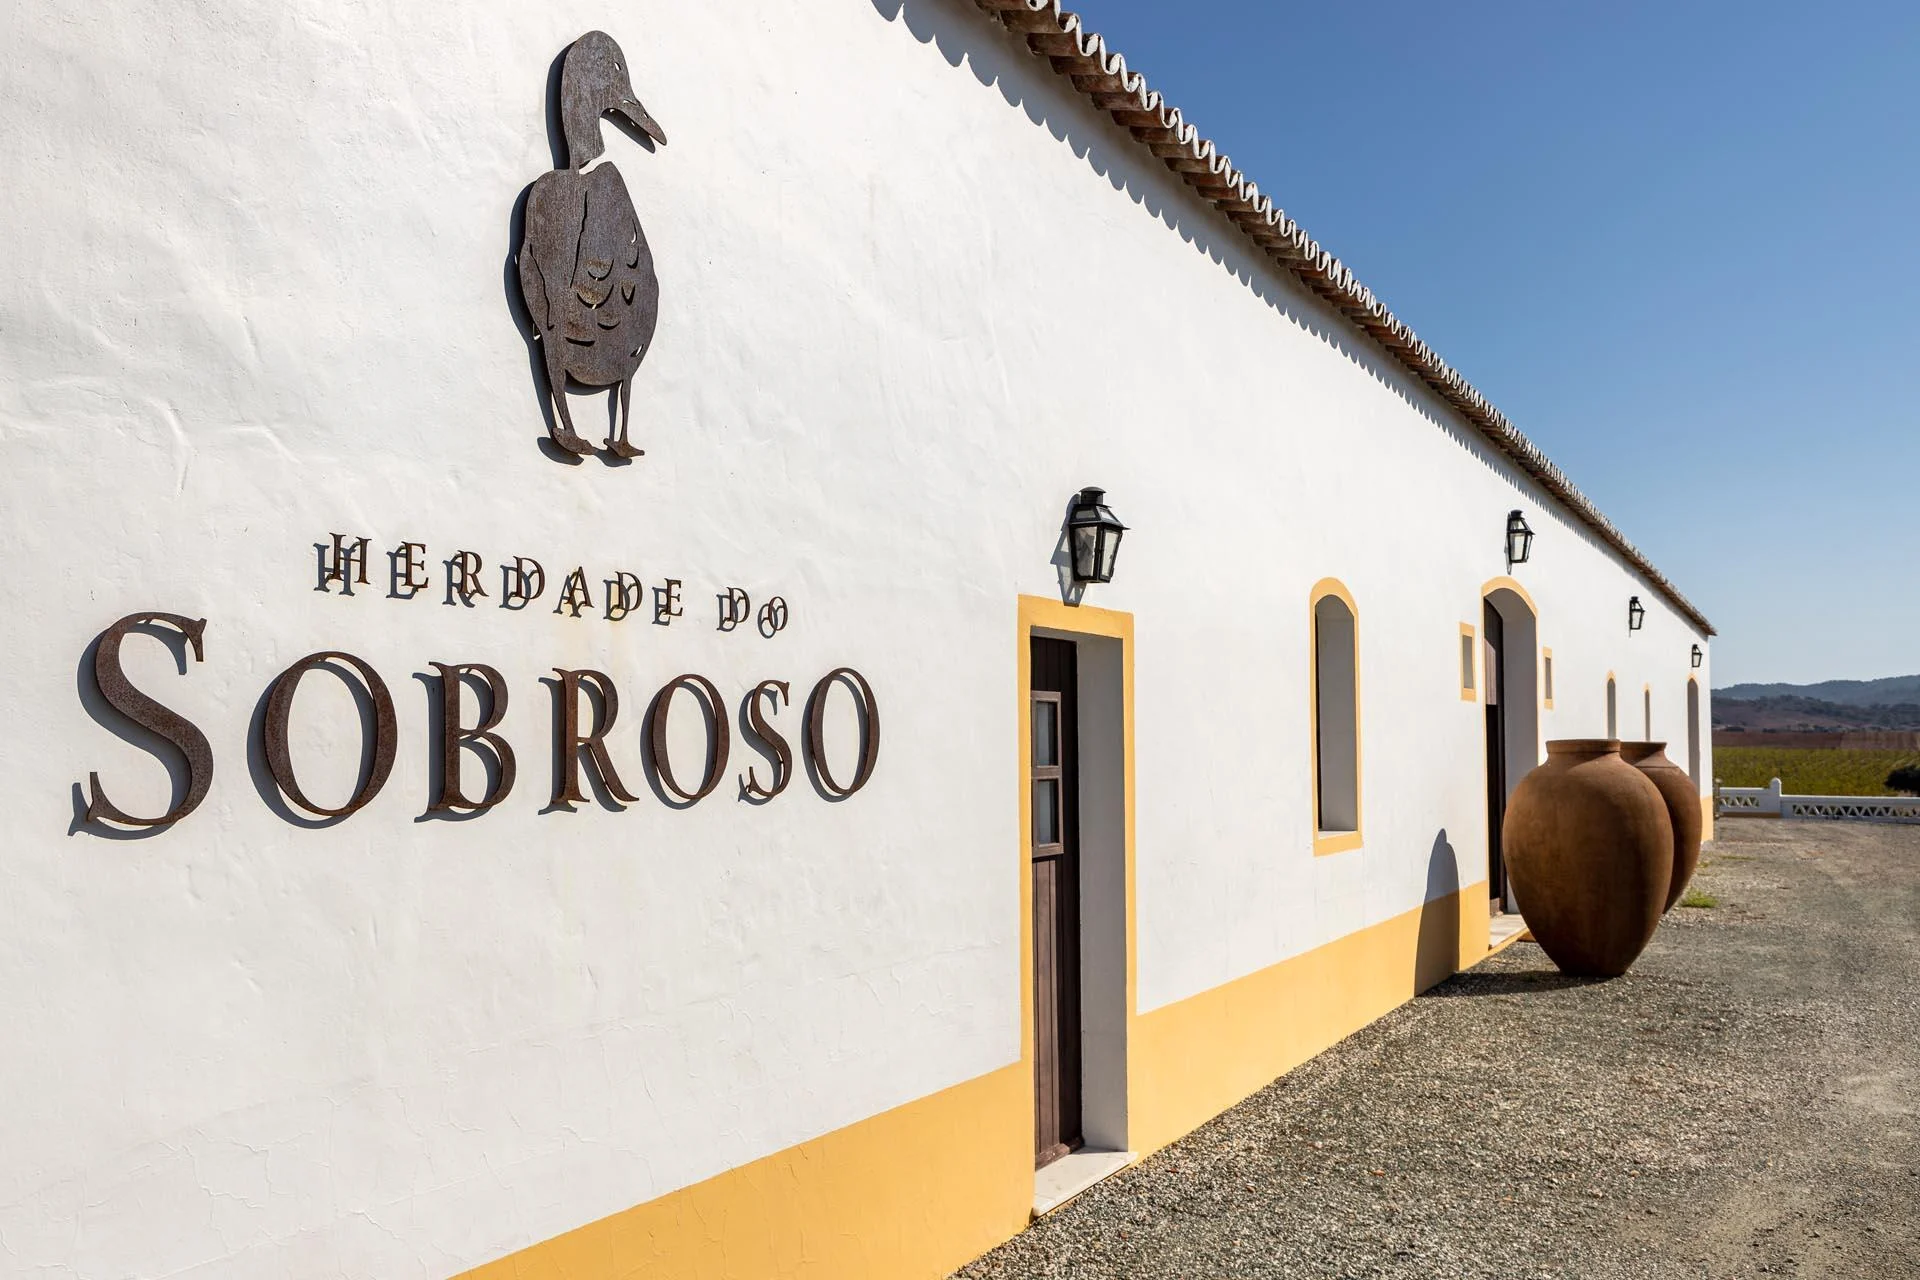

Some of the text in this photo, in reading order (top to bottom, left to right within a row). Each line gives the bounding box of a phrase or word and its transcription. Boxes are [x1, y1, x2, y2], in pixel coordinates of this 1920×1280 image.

[329, 532, 789, 631] HERDADE DO
[87, 611, 881, 826] SOBROSO
